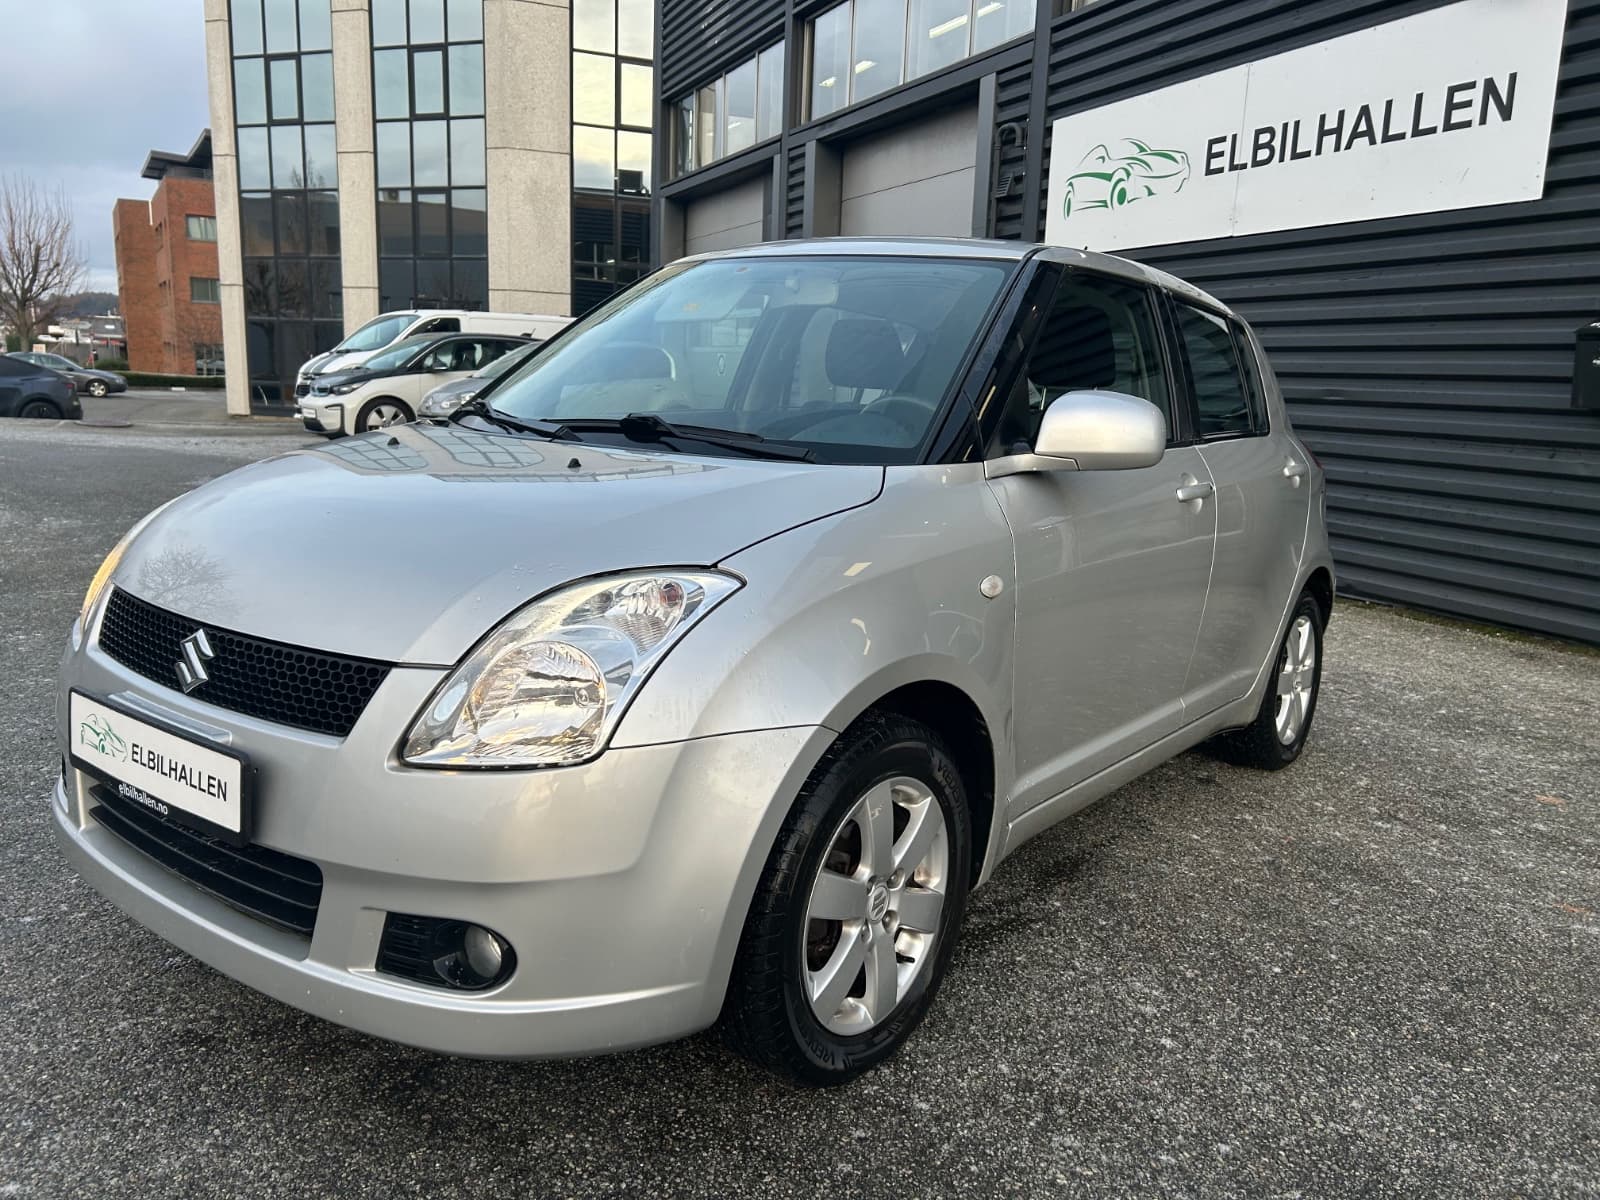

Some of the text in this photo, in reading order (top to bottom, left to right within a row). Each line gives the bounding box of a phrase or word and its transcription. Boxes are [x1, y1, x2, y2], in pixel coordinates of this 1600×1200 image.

[1204, 72, 1518, 177] ELBILHALLEN
[118, 783, 169, 815] elbilhallen.no
[131, 743, 228, 802] ELBILHALLEN
